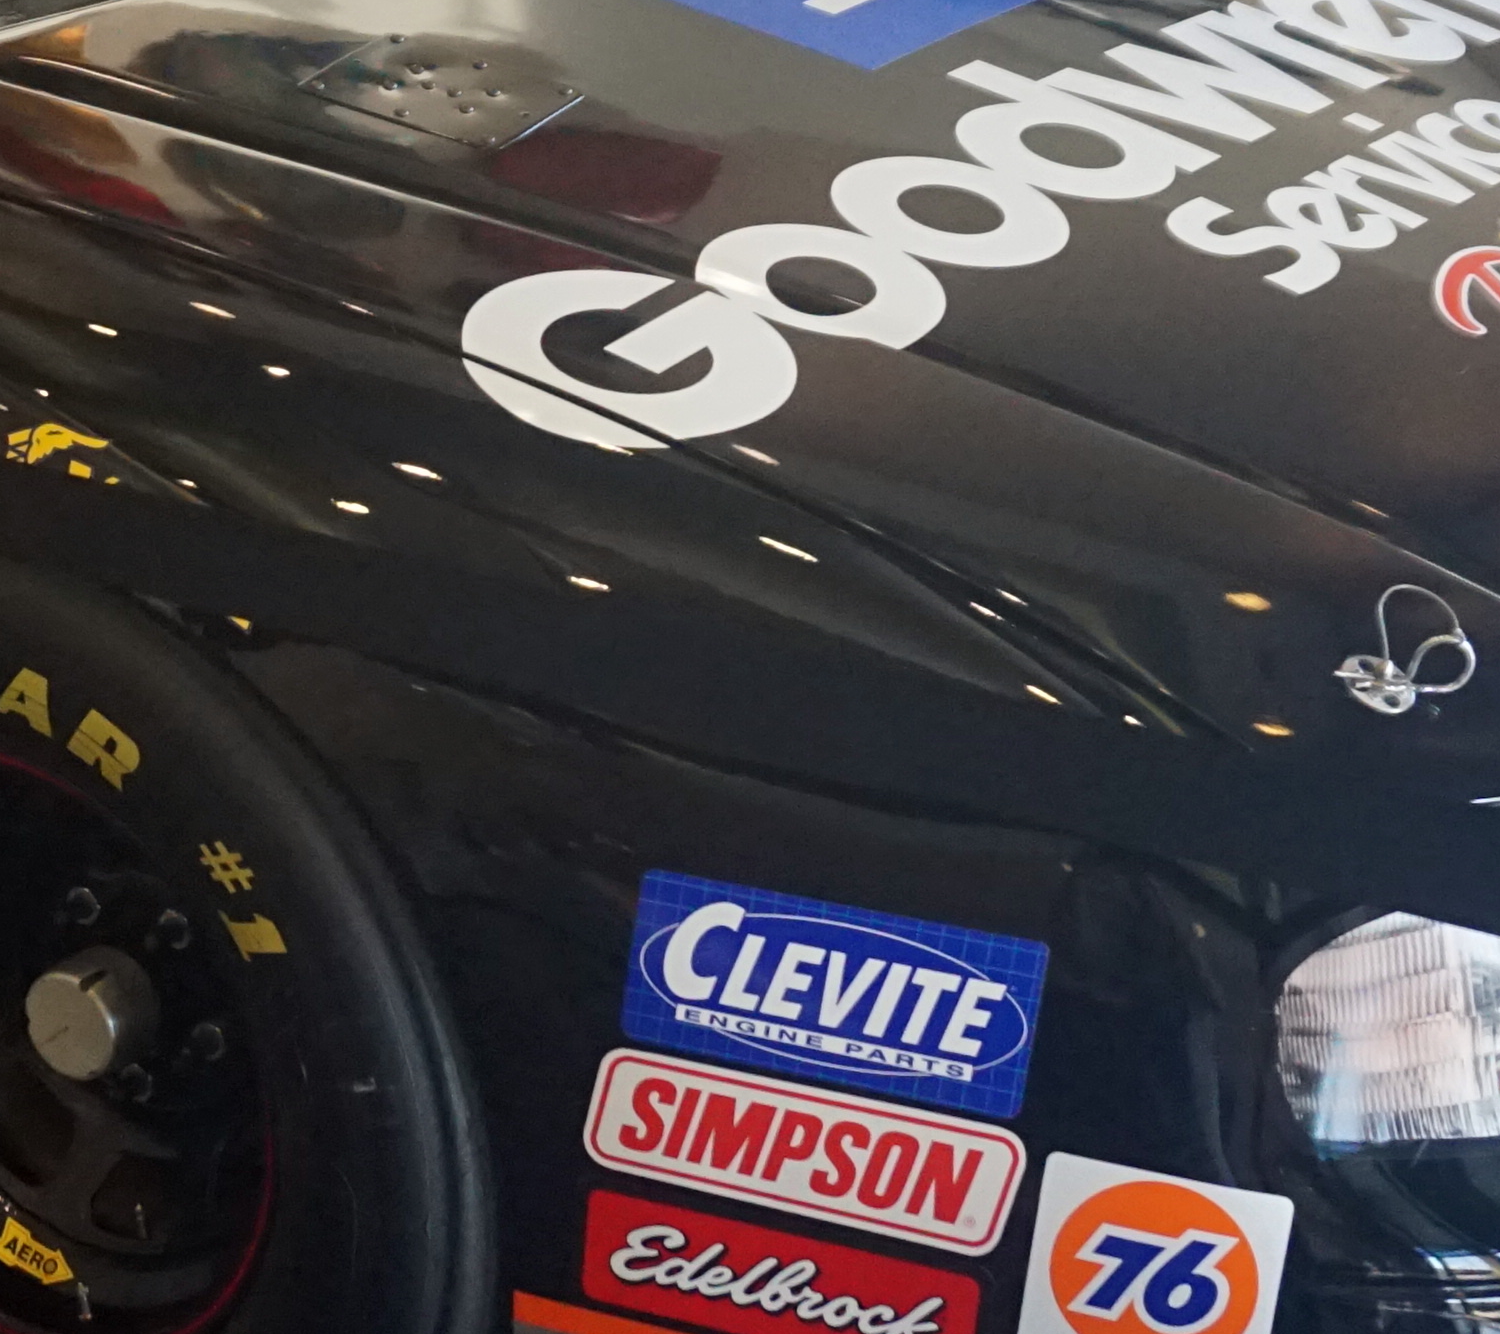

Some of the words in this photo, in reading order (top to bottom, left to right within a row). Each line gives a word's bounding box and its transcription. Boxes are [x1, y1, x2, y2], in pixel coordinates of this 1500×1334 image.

[199, 838, 289, 962] #1
[662, 900, 1008, 1058] CLEVITE
[683, 1008, 824, 1050] ENGINE
[845, 1042, 966, 1079] PARTS
[617, 1076, 985, 1226] SIMPSON
[3, 1236, 59, 1276] AERO
[1078, 1228, 1228, 1332] 76
